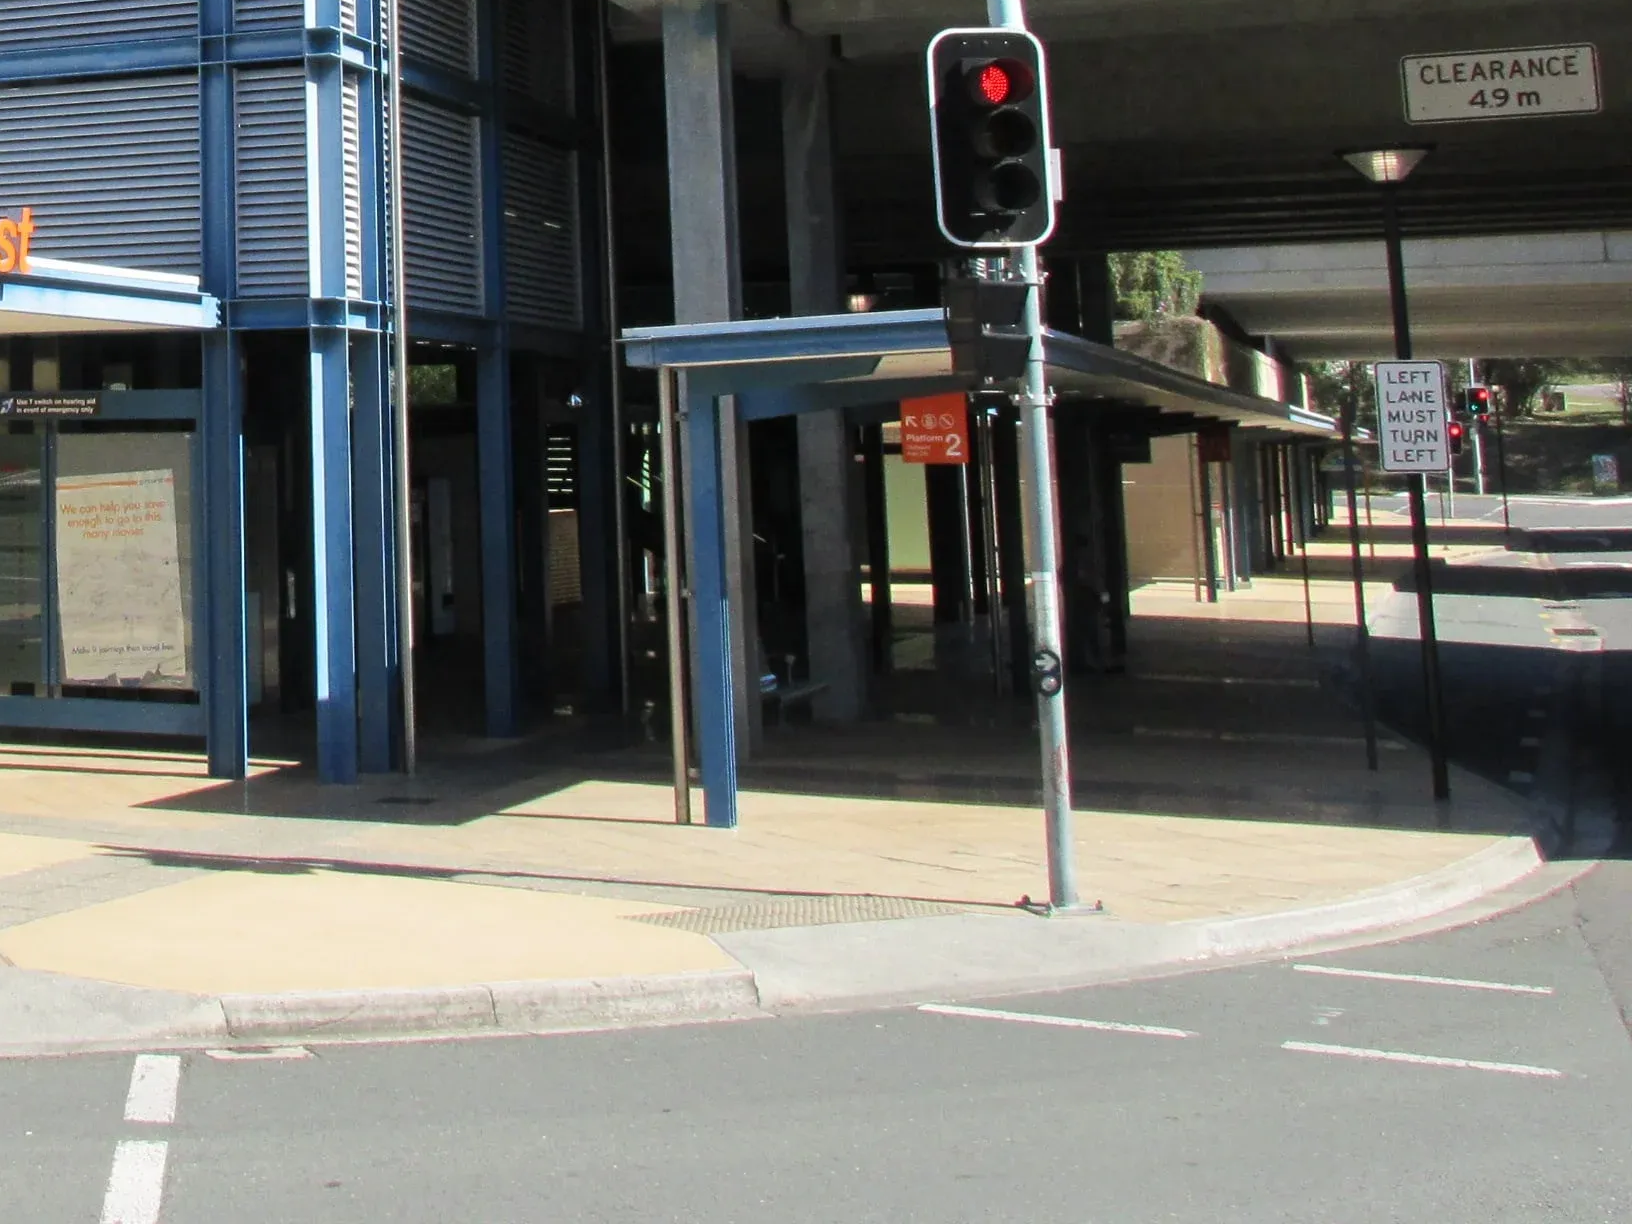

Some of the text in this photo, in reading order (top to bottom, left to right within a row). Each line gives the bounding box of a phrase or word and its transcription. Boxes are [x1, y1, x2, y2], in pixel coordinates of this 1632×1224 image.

[1420, 55, 1579, 85] CLEARANCE
[1516, 90, 1541, 106] m
[1387, 371, 1431, 384] LEFT
[63, 398, 86, 407] hearing
[86, 397, 96, 405] aid
[1386, 390, 1435, 404] LANE
[47, 407, 79, 415] emergency
[80, 407, 94, 415] only
[1388, 409, 1437, 423] MUST
[1390, 429, 1439, 443] TURN
[905, 432, 944, 443] Platform
[945, 433, 962, 456] 2
[1392, 449, 1437, 463] LEFT
[78, 504, 97, 514] can
